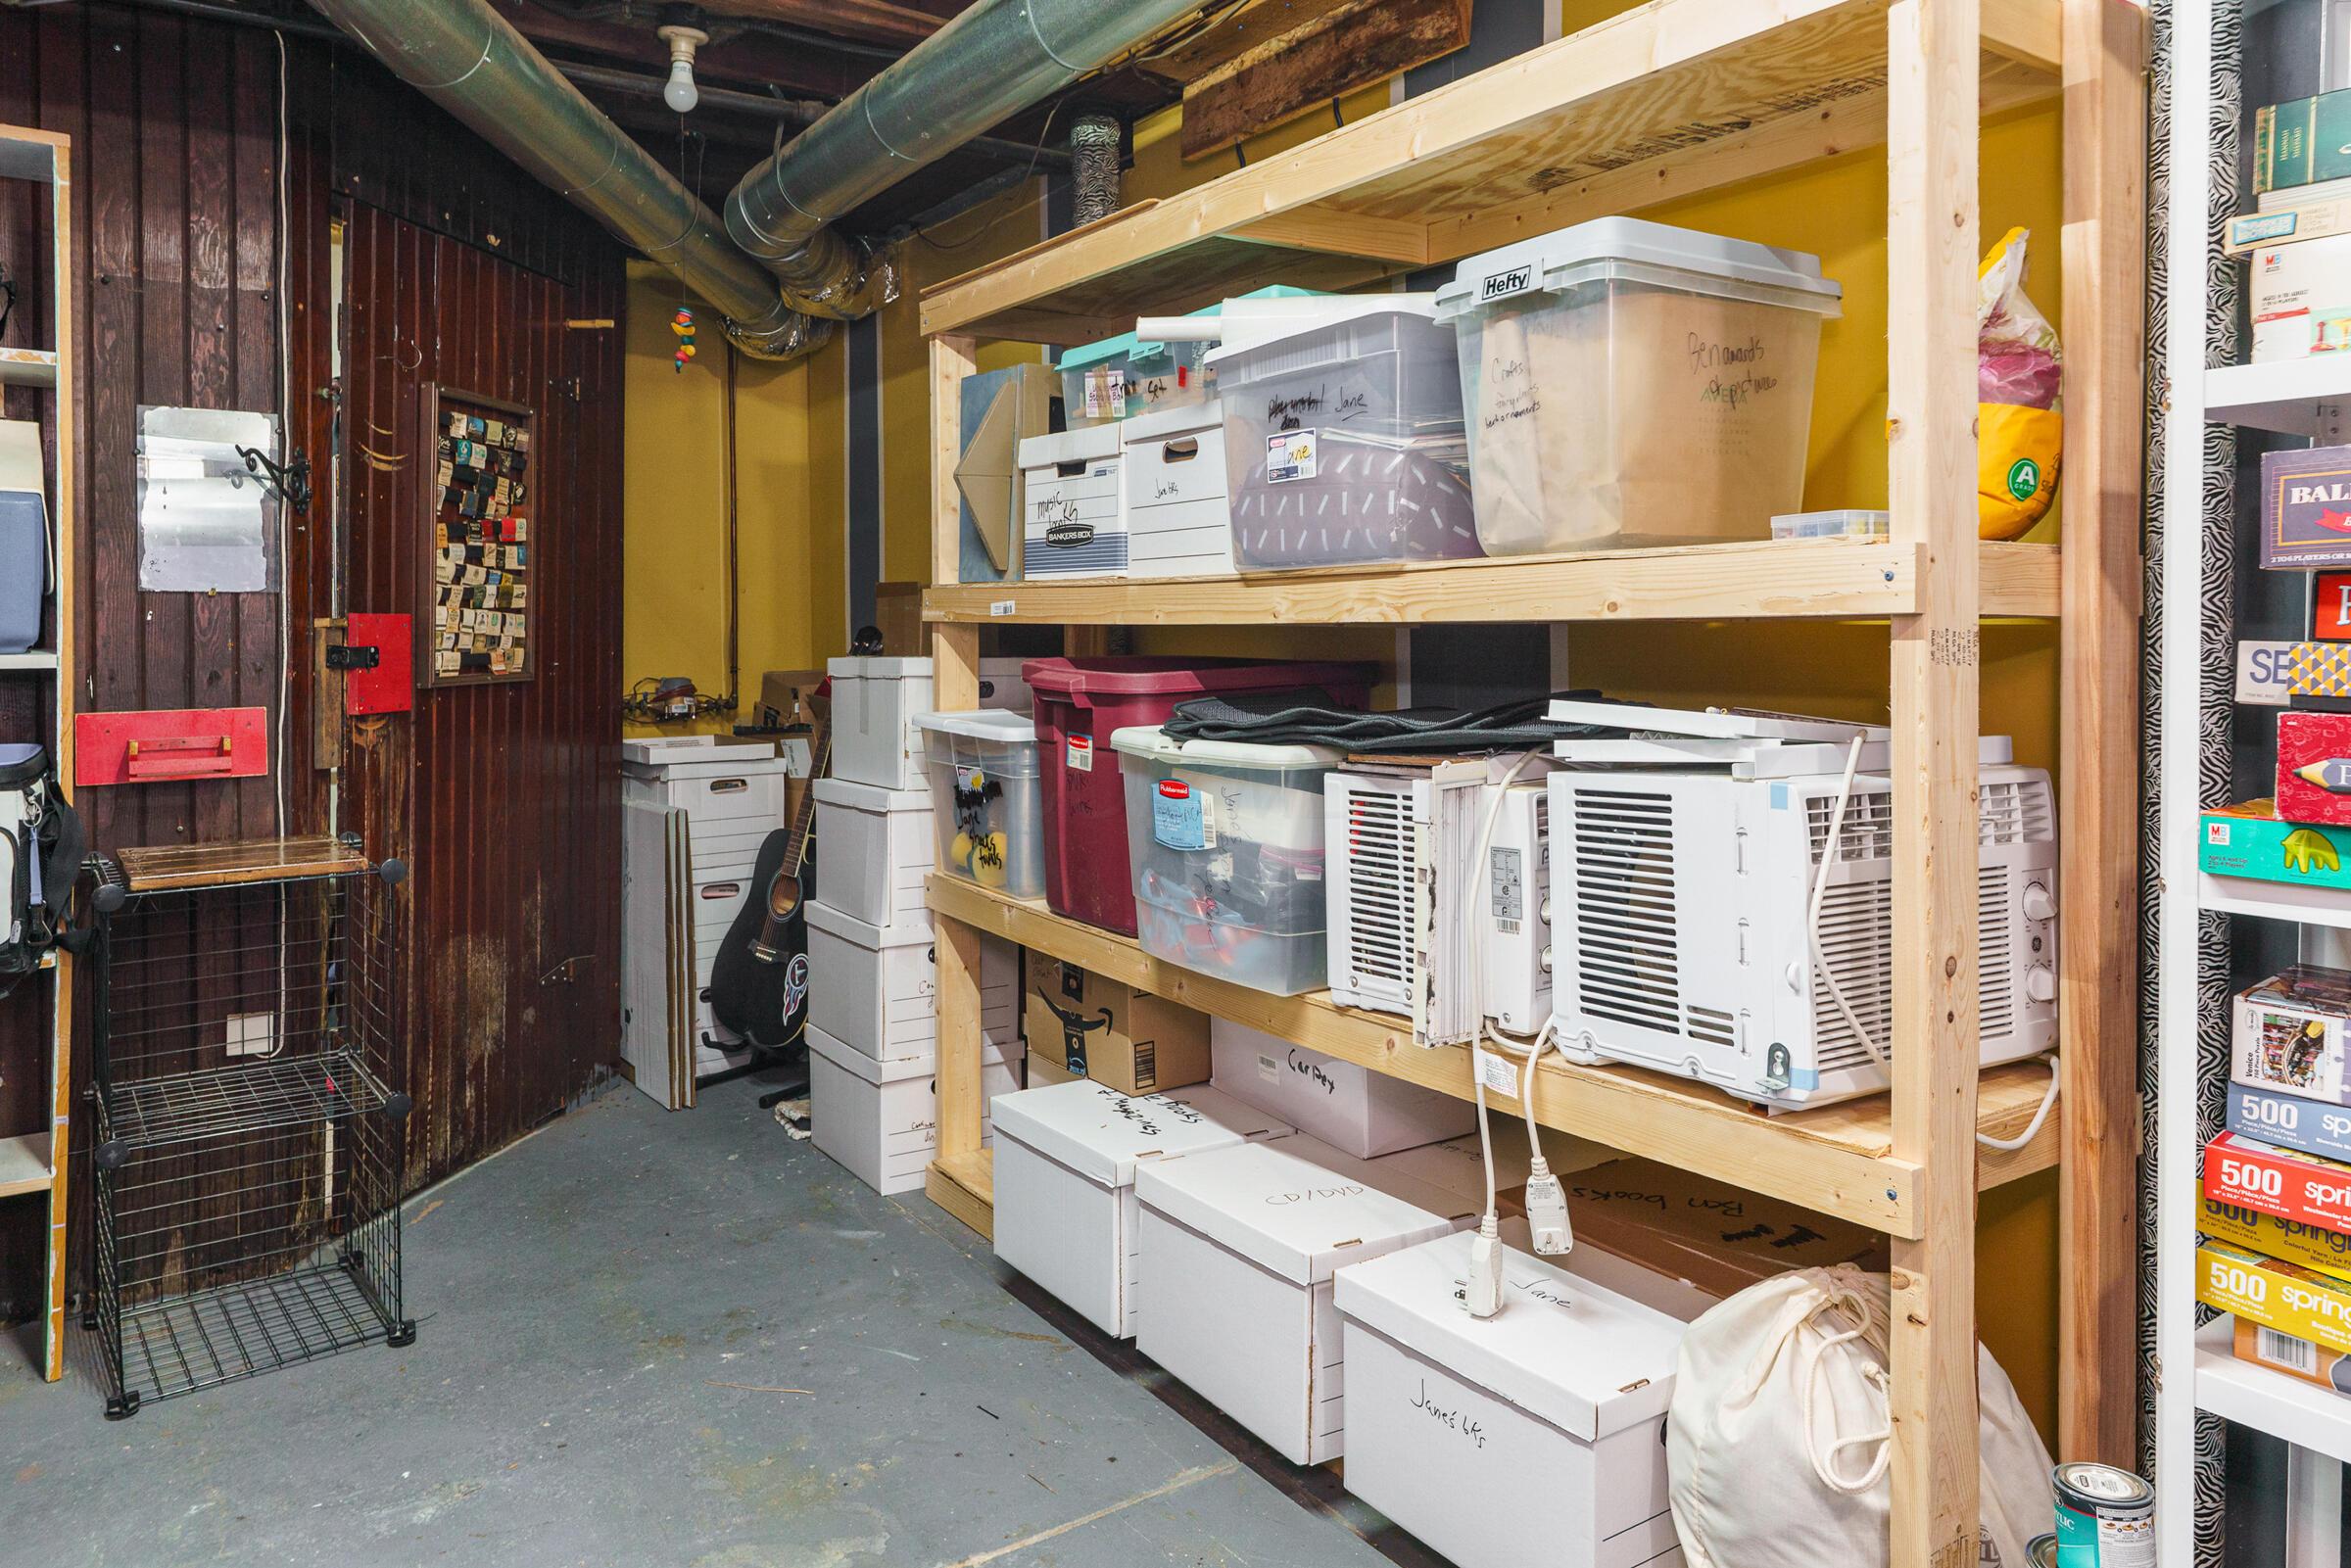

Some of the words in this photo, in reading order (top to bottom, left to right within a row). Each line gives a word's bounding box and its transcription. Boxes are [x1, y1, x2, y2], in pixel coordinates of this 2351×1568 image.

[1485, 272, 1527, 296] Hefty
[1334, 386, 1367, 412] Jane
[2016, 466, 2035, 486] A
[1048, 530, 1078, 542] BANKERS
[1078, 529, 1092, 539] BOX
[1160, 784, 1188, 794] Rubbermaid
[2245, 1052, 2254, 1078] Venice
[2241, 1094, 2298, 1129] 500
[2221, 1159, 2282, 1197] 500
[2283, 1240, 2311, 1253] Colorful
[2313, 1249, 2328, 1259] Yarn
[1510, 1277, 1574, 1309] Jane
[2210, 1261, 2267, 1303] 500
[1410, 1378, 1457, 1429] Jane's
